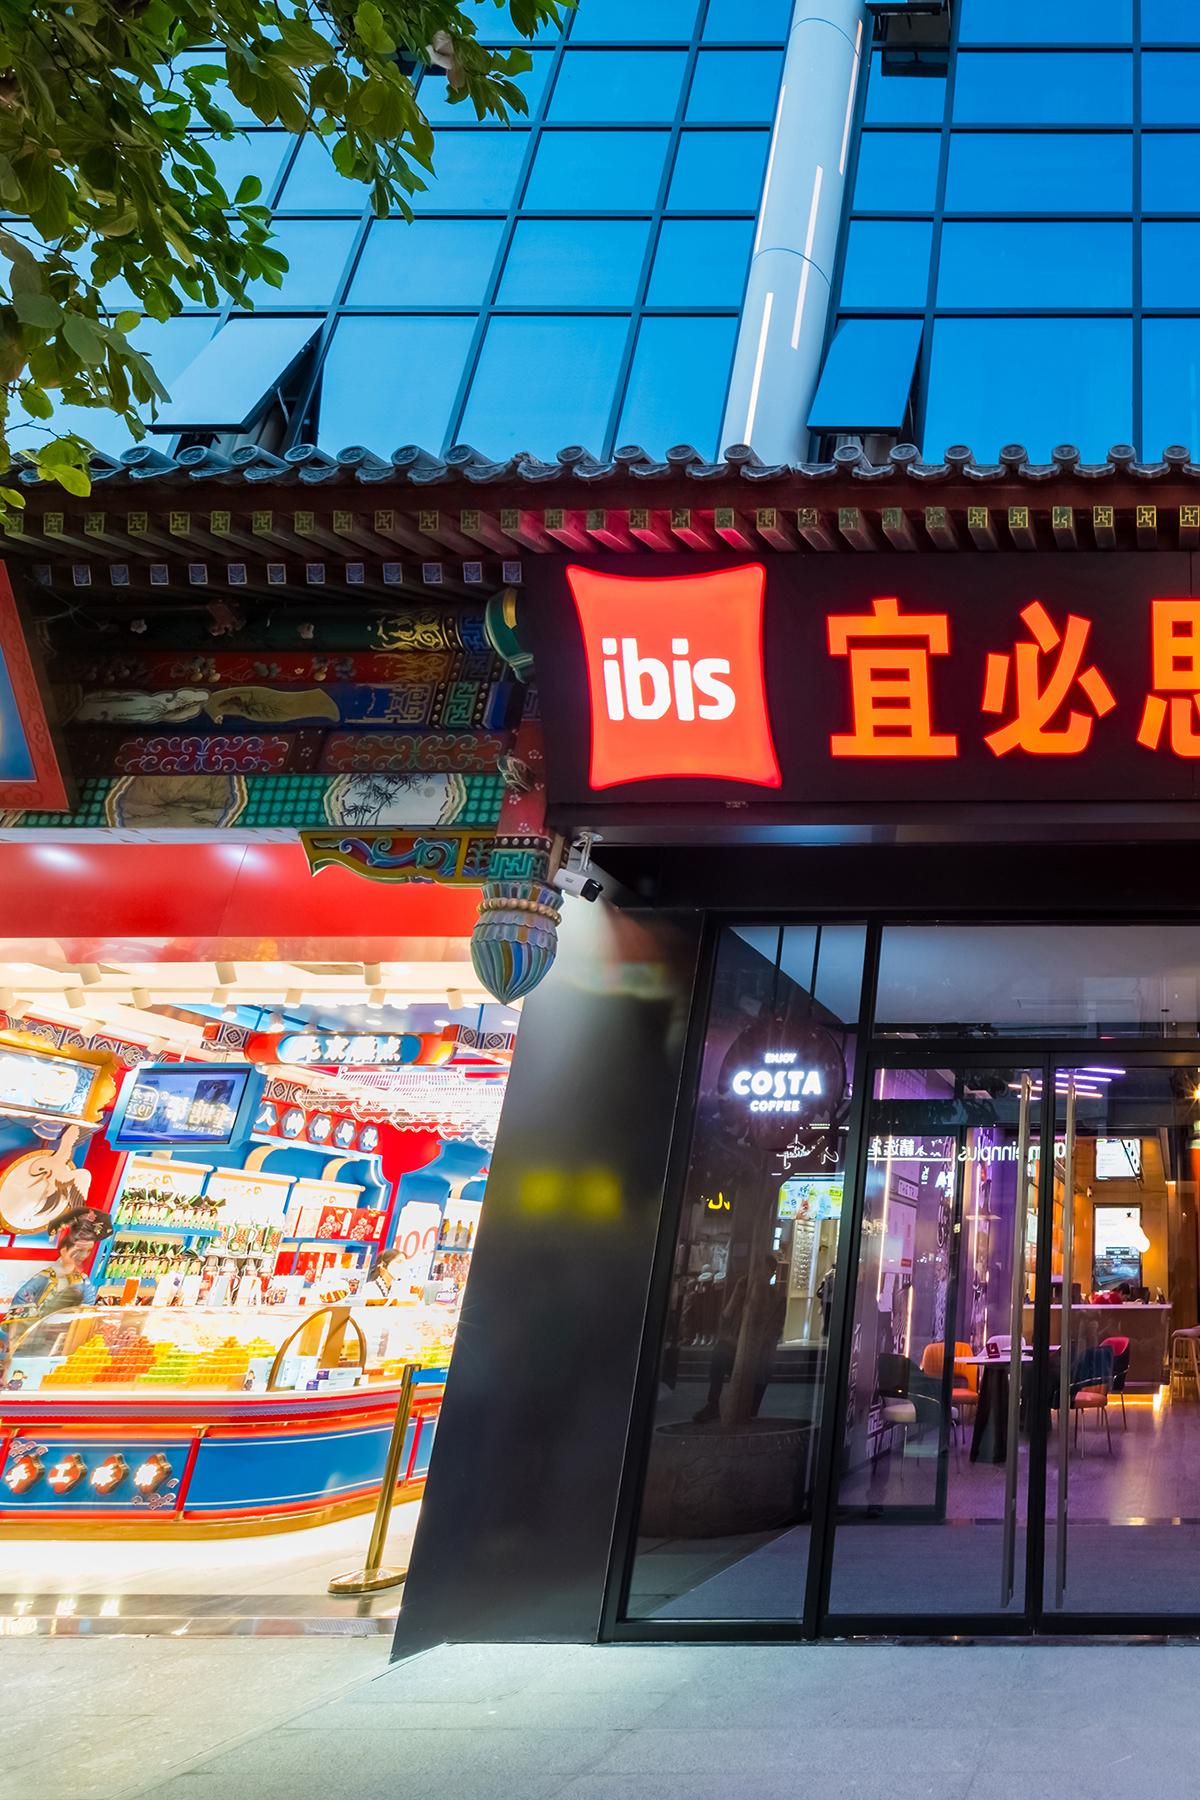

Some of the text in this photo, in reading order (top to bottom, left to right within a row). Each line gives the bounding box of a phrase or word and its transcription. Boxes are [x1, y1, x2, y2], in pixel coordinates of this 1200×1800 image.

[601, 637, 736, 721] ibis
[764, 1052, 798, 1064] ENJOY
[732, 1070, 822, 1099] COSTA
[750, 1099, 801, 1112] COFFEE
